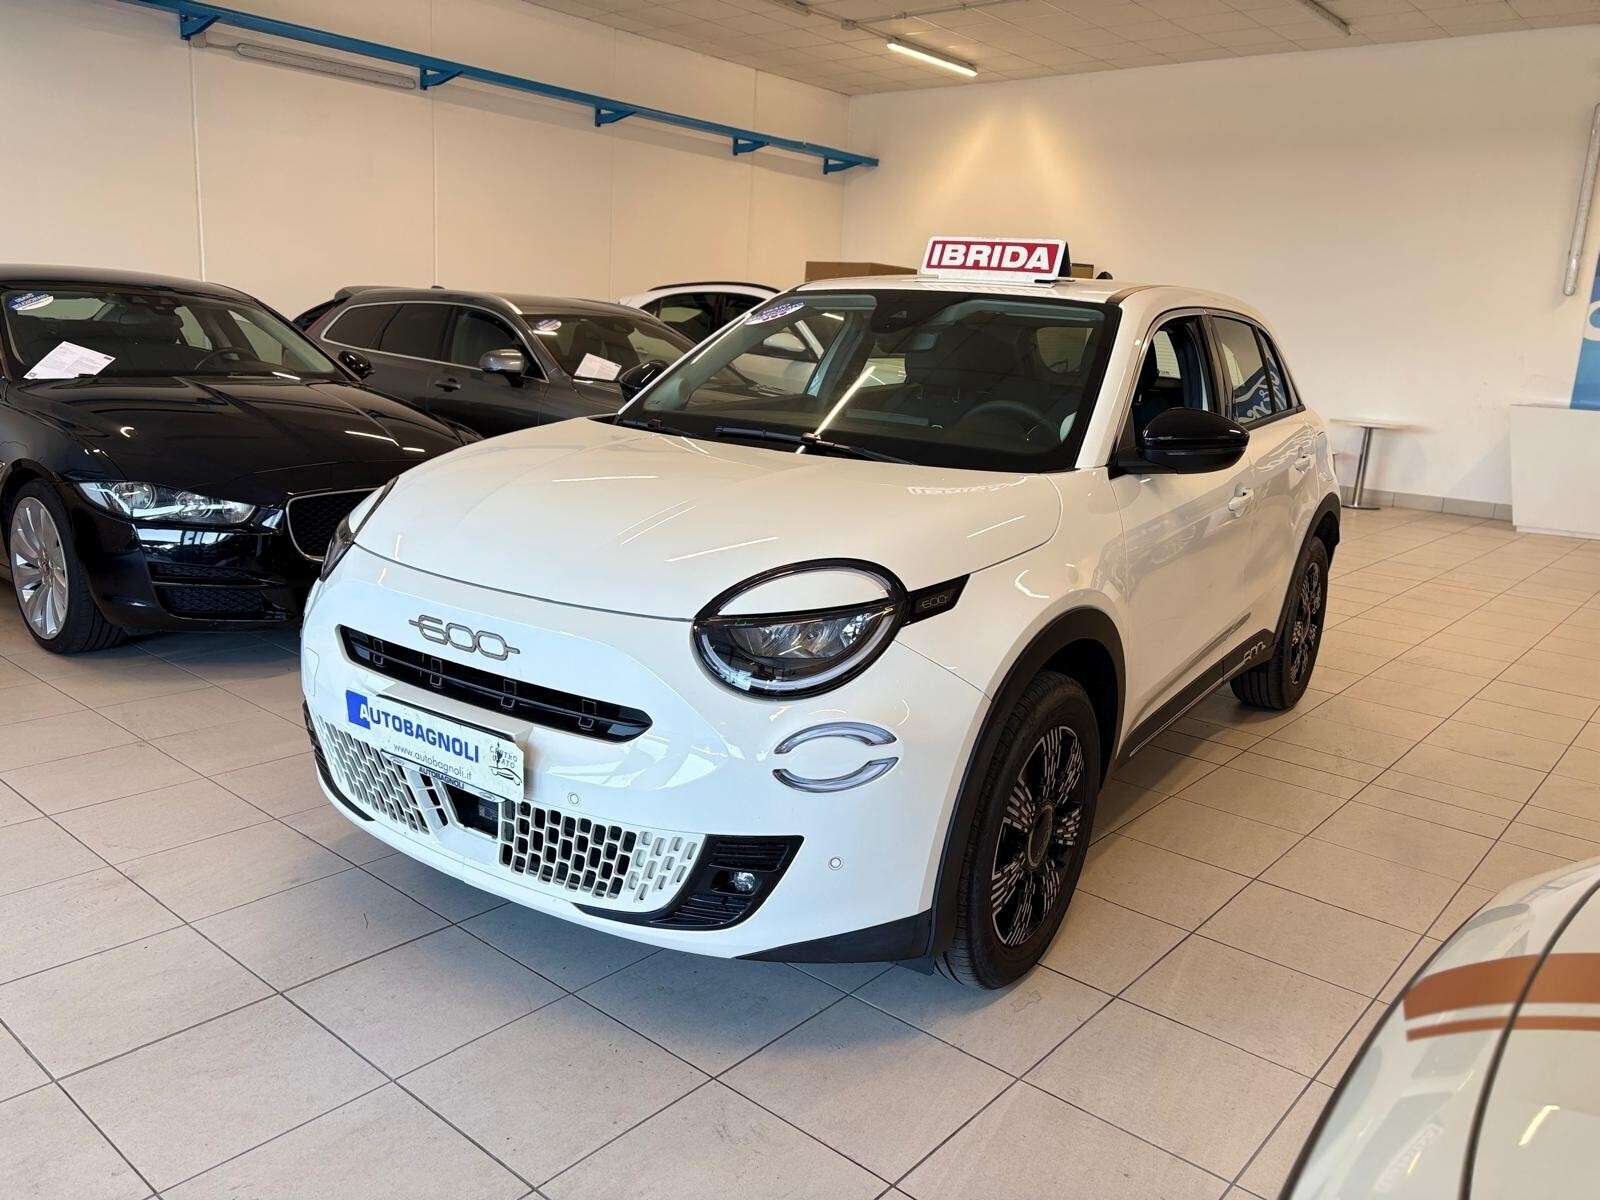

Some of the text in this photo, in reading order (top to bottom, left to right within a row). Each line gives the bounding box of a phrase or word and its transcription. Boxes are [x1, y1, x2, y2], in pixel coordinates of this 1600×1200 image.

[930, 243, 1050, 271] IBRIDA
[409, 614, 520, 661] 600
[359, 703, 479, 763] AUTOBAGNOLI
[393, 744, 472, 780] www.autobagnoli.it
[418, 766, 465, 790] AUTOBAGNOLI
